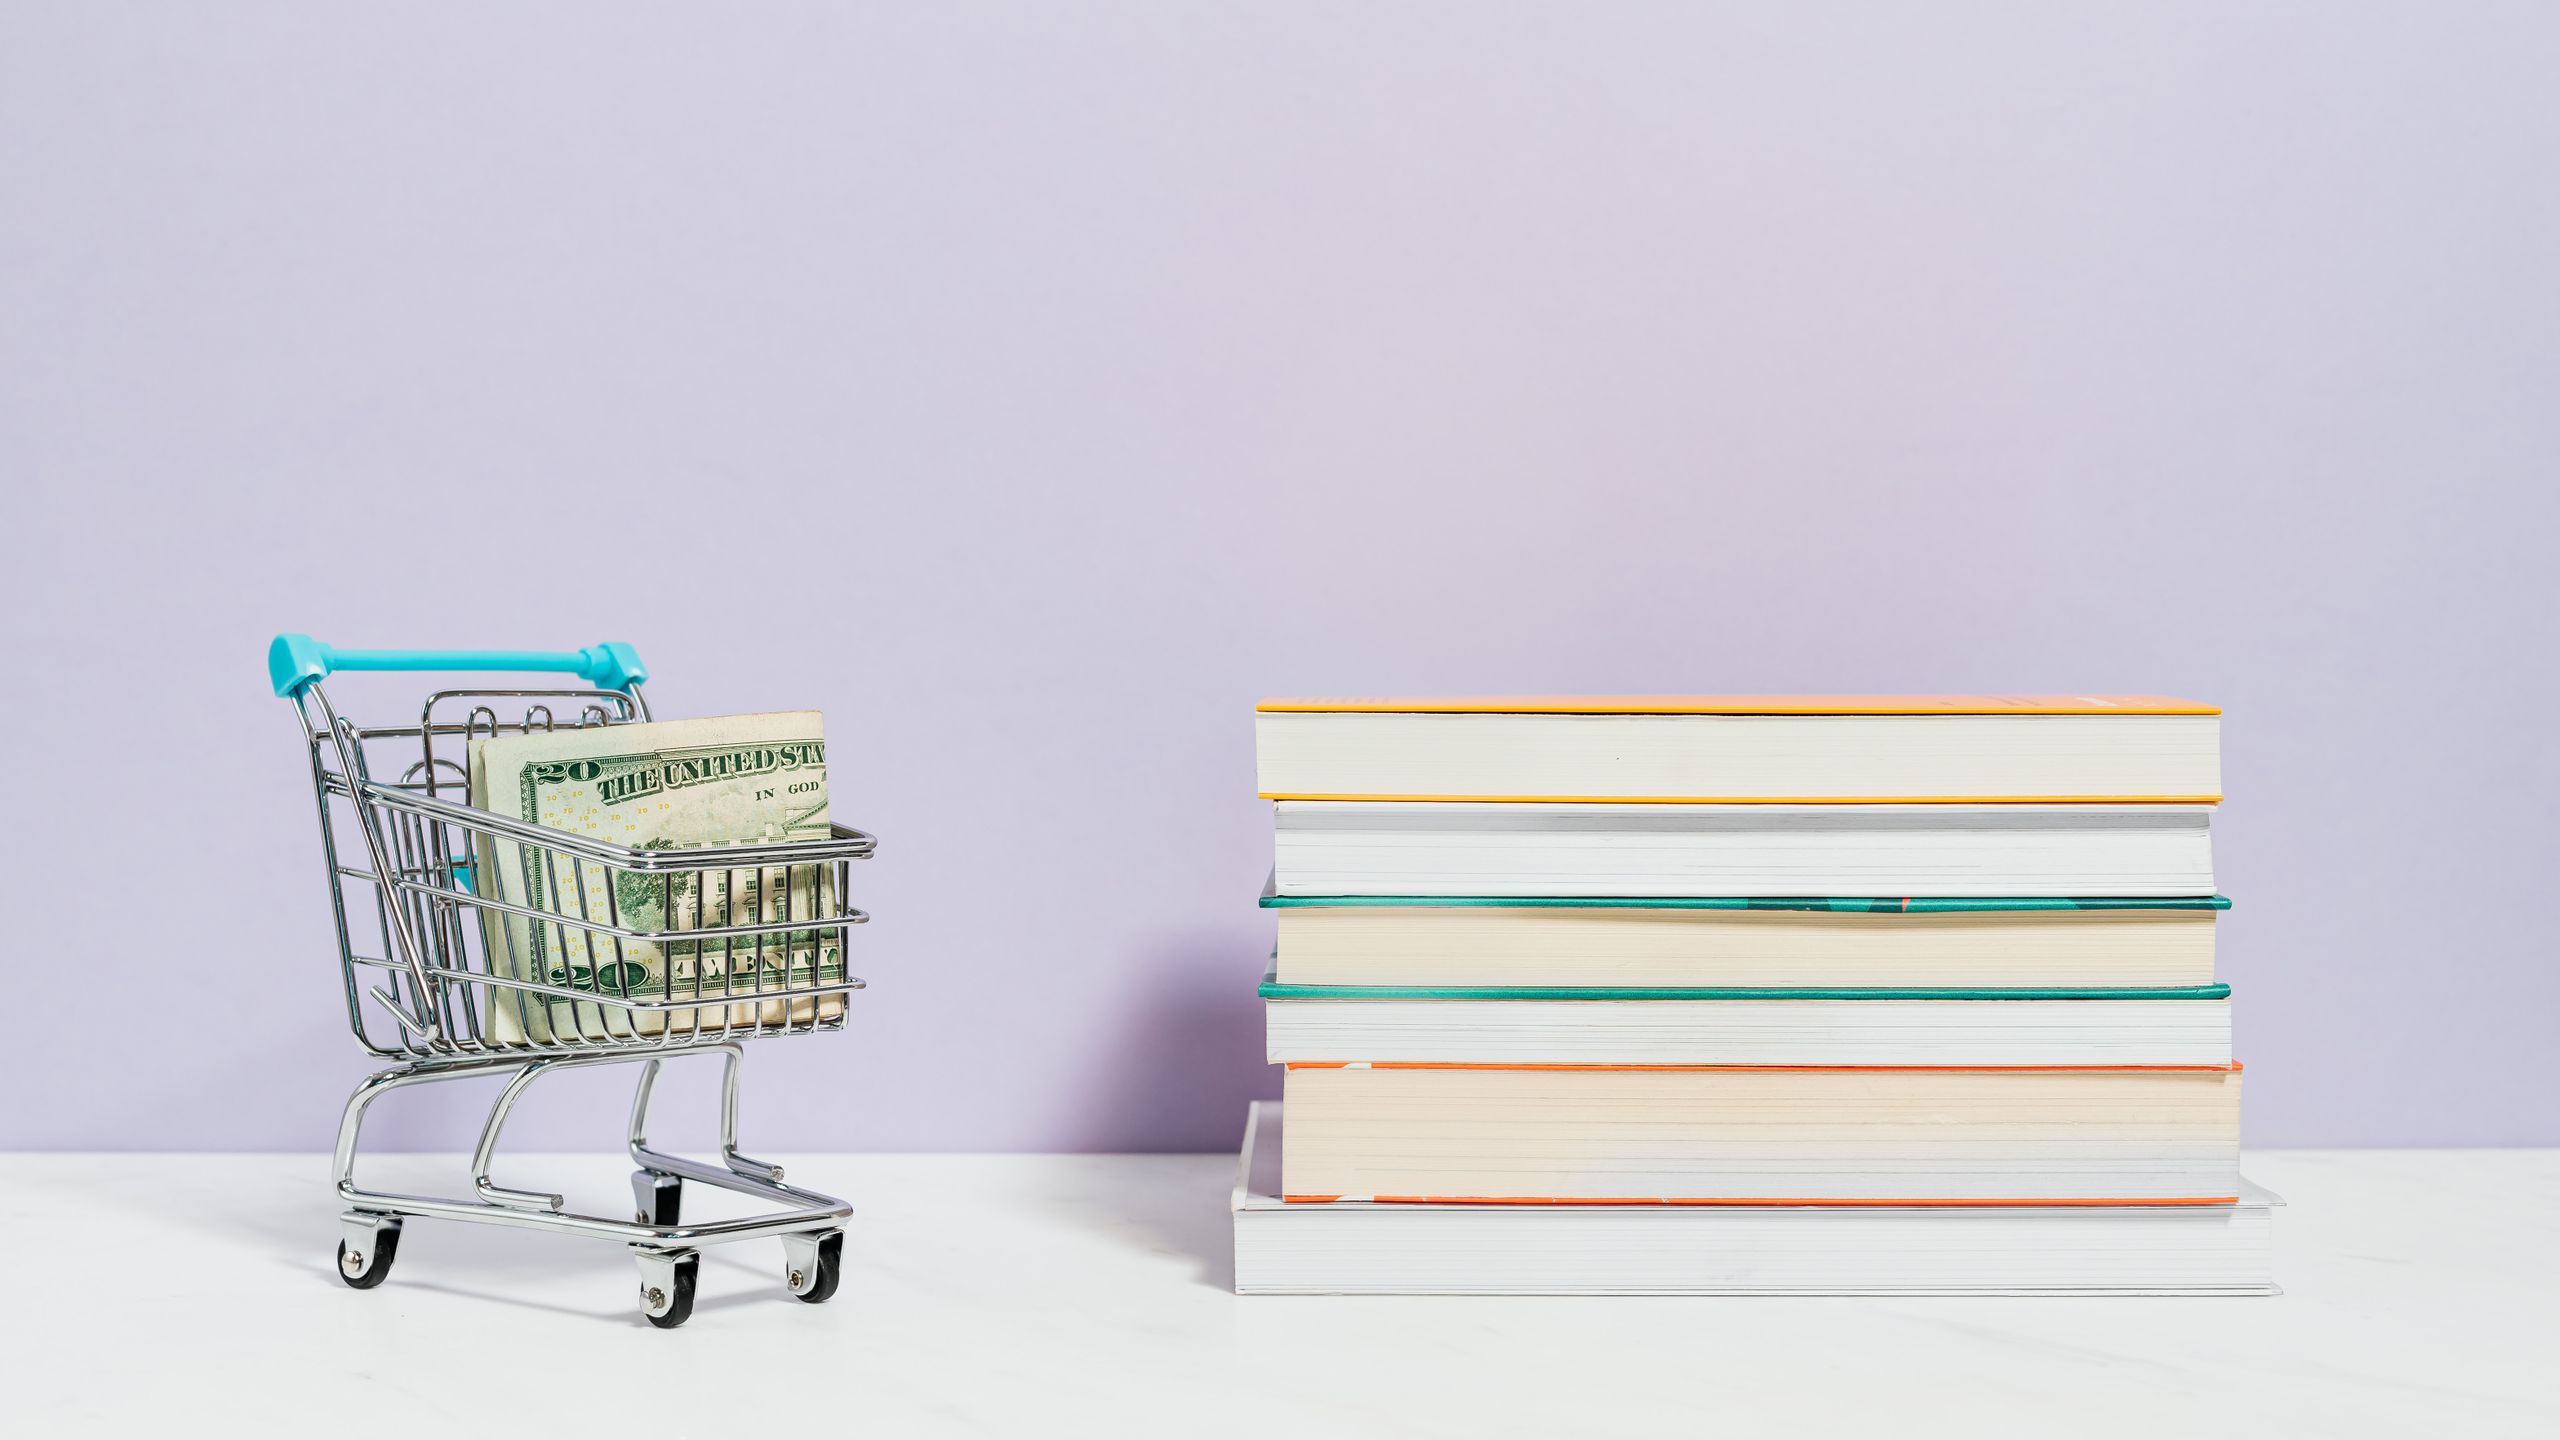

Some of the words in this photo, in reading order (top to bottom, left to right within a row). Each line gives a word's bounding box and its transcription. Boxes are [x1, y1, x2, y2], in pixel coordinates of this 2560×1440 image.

[535, 761, 602, 784] 20
[597, 767, 664, 805] THE
[663, 749, 778, 789] UNITED
[755, 788, 775, 801] IN
[788, 781, 819, 794] GOD
[549, 960, 651, 992] 20
